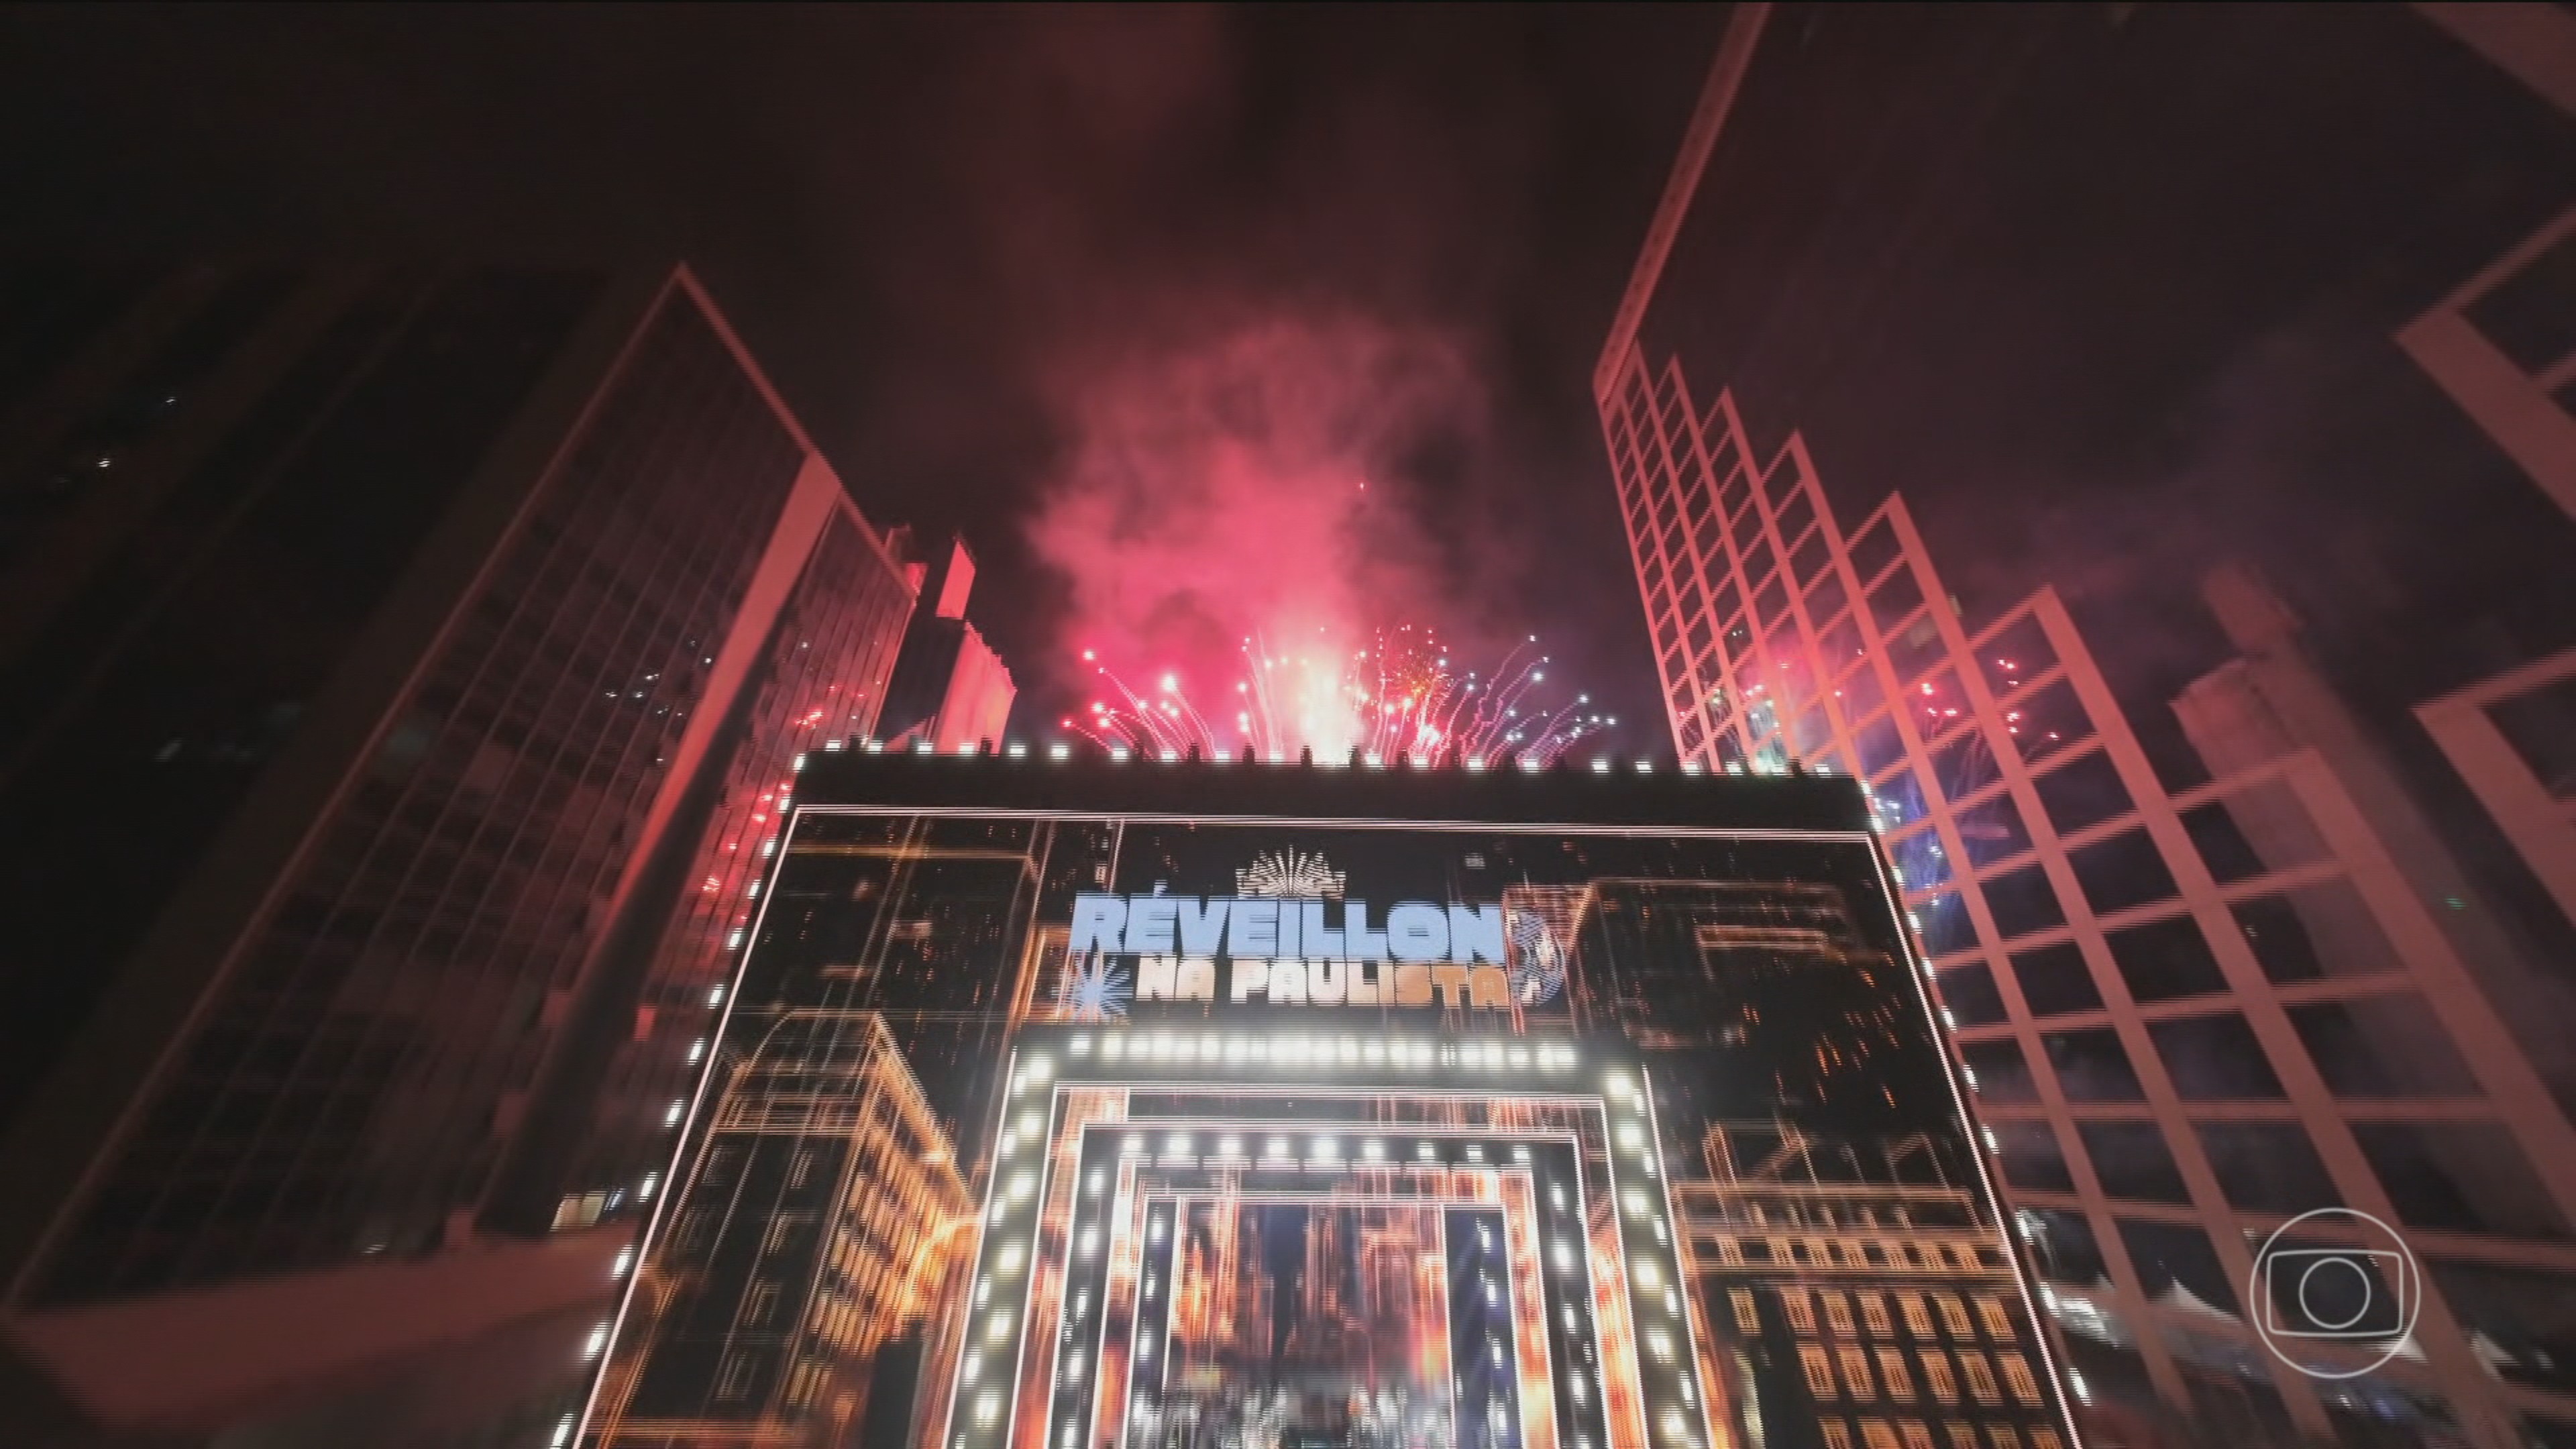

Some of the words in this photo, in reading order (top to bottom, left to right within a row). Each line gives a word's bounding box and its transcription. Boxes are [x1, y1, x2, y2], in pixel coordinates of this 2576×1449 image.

[1071, 880, 1505, 964] RÉVEILLON
[1135, 955, 1215, 1003] NA
[1230, 959, 1511, 1010] PAULISTA
